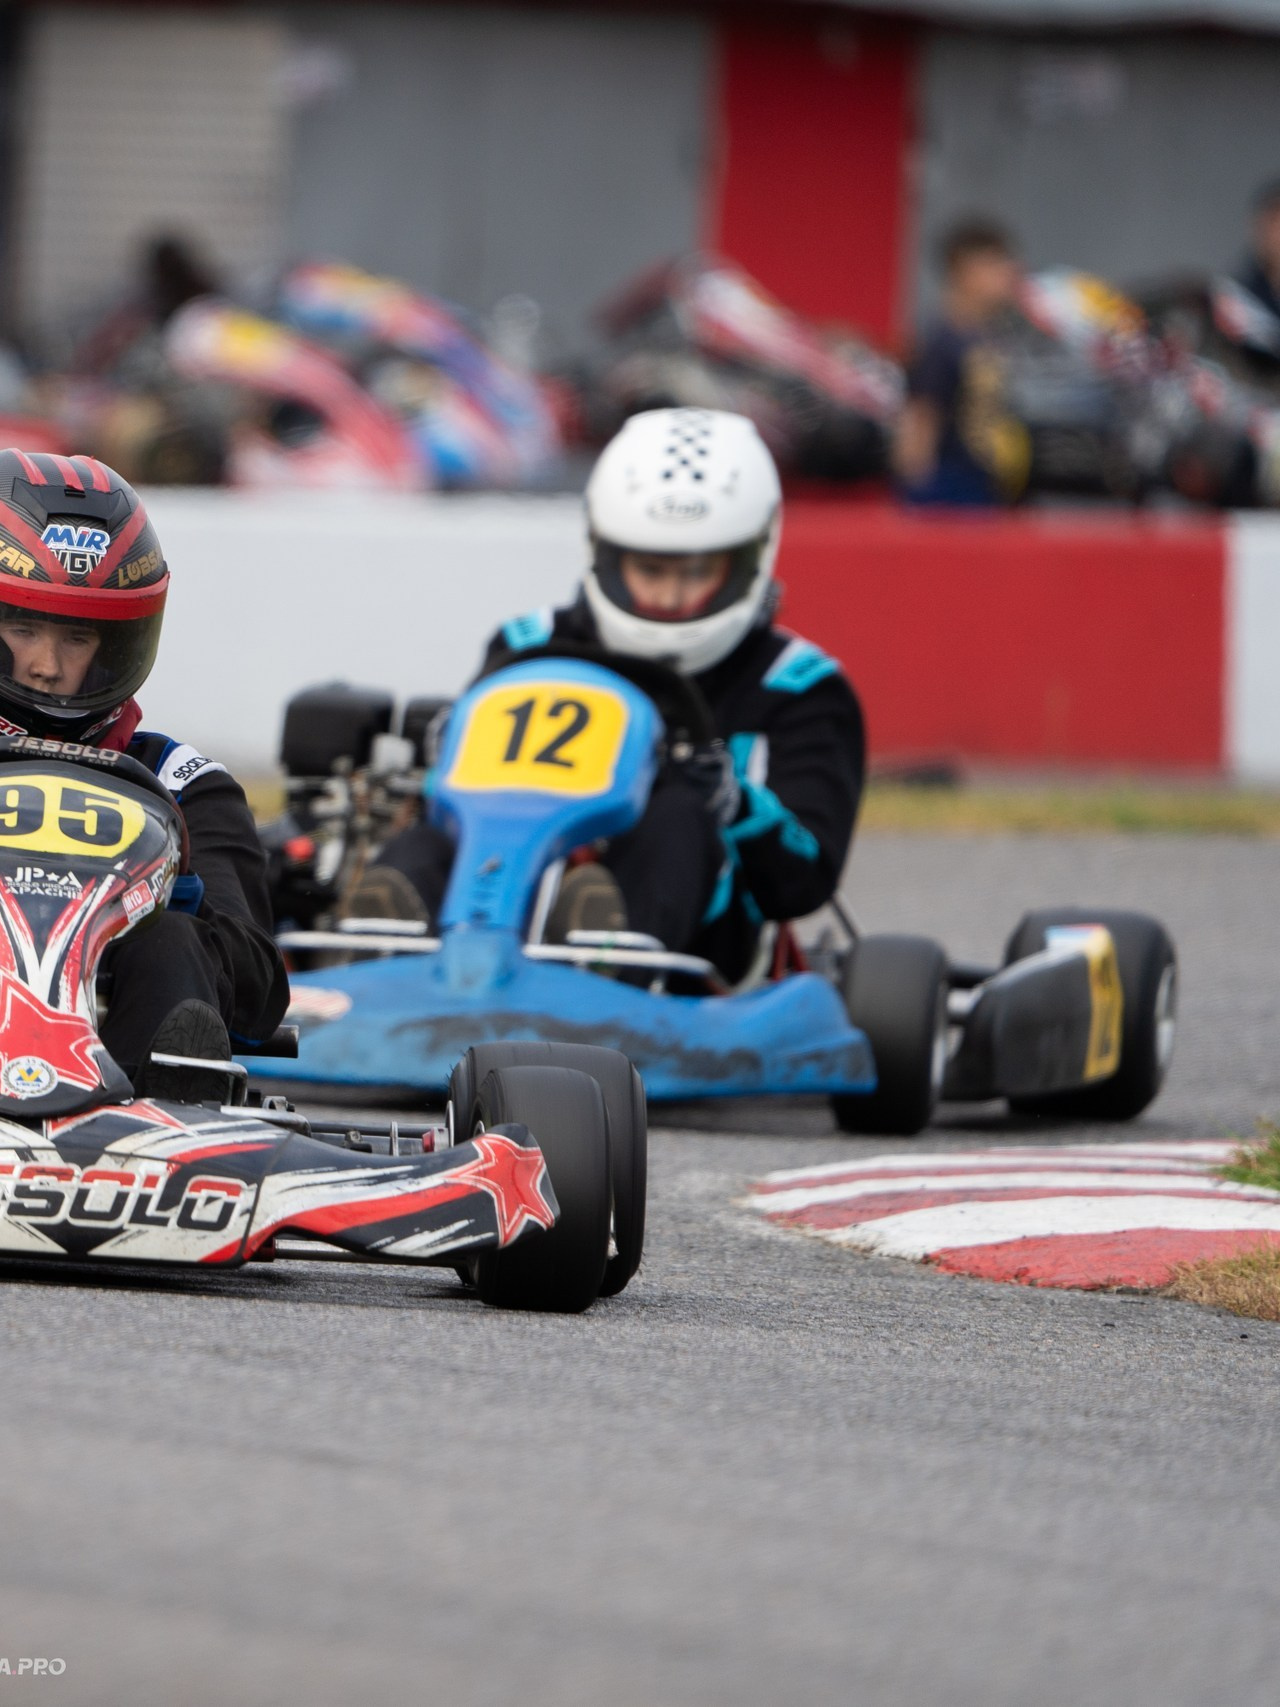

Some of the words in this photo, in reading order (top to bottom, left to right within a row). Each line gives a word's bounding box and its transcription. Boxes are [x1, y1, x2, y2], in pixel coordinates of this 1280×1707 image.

[503, 697, 590, 768] 12
[8, 747, 80, 761] TECHNOLOGY
[87, 757, 116, 767] KART
[10, 736, 119, 761] JESOLO
